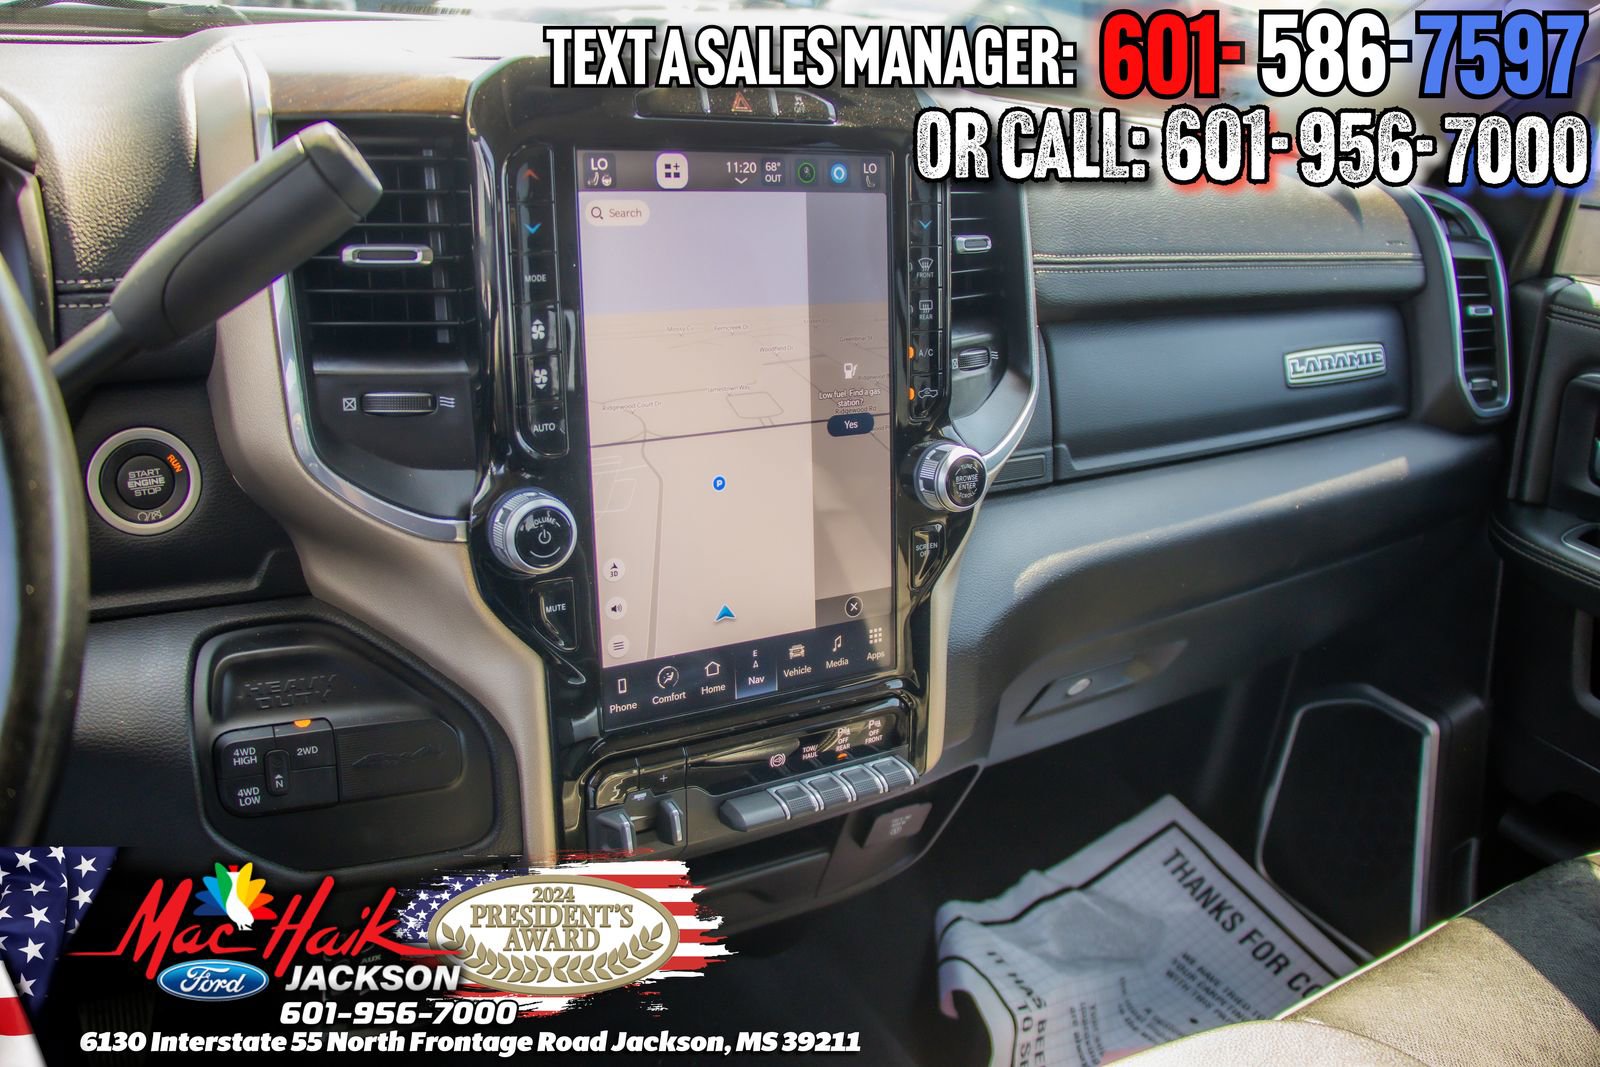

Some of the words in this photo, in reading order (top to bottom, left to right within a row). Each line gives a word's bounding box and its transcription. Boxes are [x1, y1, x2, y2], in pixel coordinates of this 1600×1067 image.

[590, 157, 609, 171] LO
[725, 161, 757, 175] 11:20
[764, 162, 782, 173] 68°
[862, 162, 878, 175] LO
[764, 174, 783, 184] OUT
[608, 207, 643, 219] Search
[524, 273, 548, 283] MODE
[916, 271, 935, 279] FRONT
[918, 348, 934, 357] A/C
[1289, 350, 1384, 379] LARAMIE
[818, 392, 833, 400] Low
[849, 388, 864, 397] Find
[869, 388, 881, 397] gas
[836, 398, 864, 407] station?
[532, 422, 556, 433] AUTO
[843, 420, 859, 430] Yes
[166, 454, 183, 474] RUN
[128, 467, 161, 478] START
[955, 473, 979, 481] BROWSE
[127, 476, 165, 489] ENGINE
[958, 481, 977, 490] ENTER
[134, 486, 162, 497] STOP
[915, 542, 938, 551] SCREEN
[610, 570, 619, 578] 3D
[545, 603, 567, 612] MUTE
[866, 650, 886, 662] Apps
[825, 657, 849, 669] Media
[783, 665, 812, 678] Vehicle
[747, 674, 765, 686] Nav
[701, 683, 726, 695] Home
[652, 690, 687, 705] Comfort
[609, 701, 638, 714] Phone
[868, 728, 880, 737] OFF
[837, 736, 849, 745] OFF
[864, 734, 884, 744] FRONT
[233, 747, 257, 757] 4WD
[296, 745, 319, 756] 2WD
[835, 743, 851, 752] REAR
[233, 755, 258, 766] HIGH
[802, 751, 818, 760] HAUL
[275, 779, 284, 788] N
[237, 787, 260, 797] 4WD
[239, 795, 261, 807] LOW
[1162, 847, 1245, 933] THANKS
[1238, 928, 1291, 977] FOR
